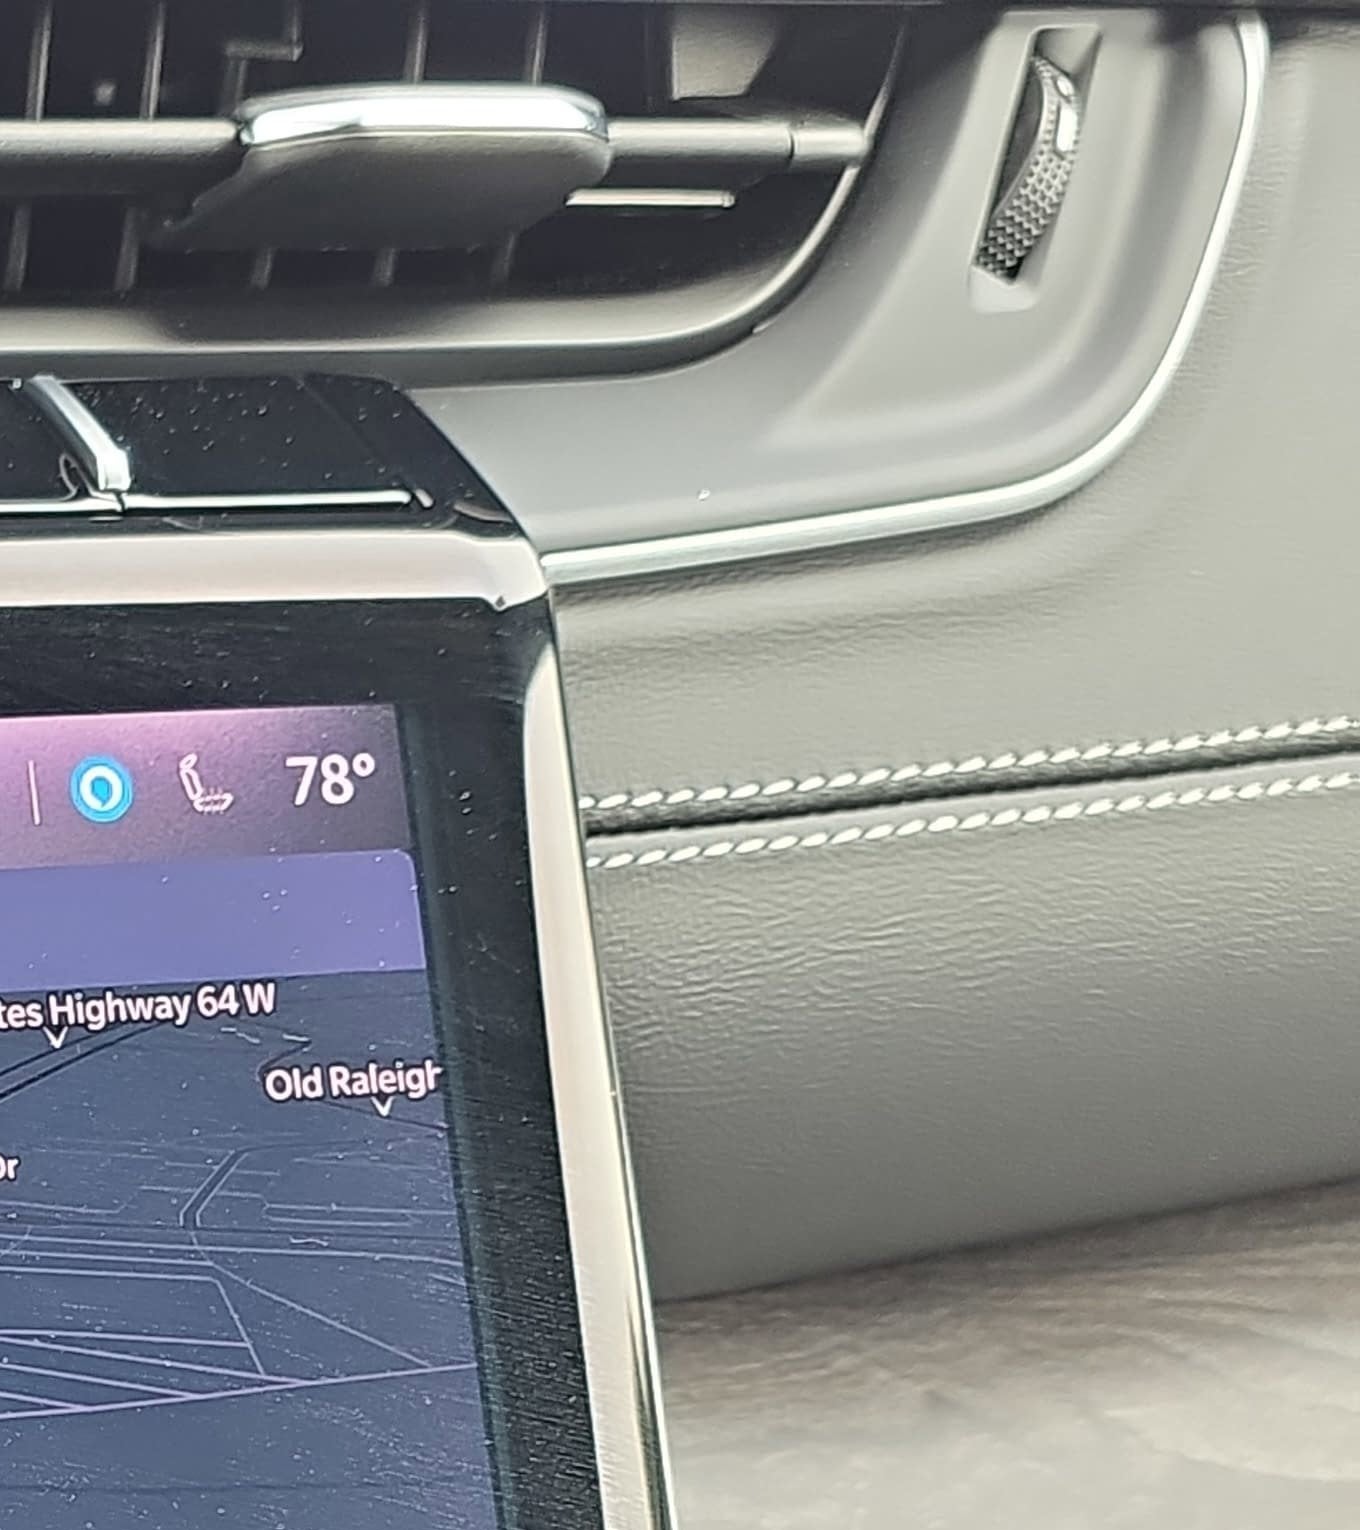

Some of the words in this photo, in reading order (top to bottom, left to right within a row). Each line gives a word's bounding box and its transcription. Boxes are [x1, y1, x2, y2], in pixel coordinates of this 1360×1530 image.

[285, 752, 376, 806] 78°
[49, 990, 192, 1029] Highway
[195, 986, 240, 1017] 64
[241, 984, 277, 1013] W
[265, 1065, 324, 1101] Old
